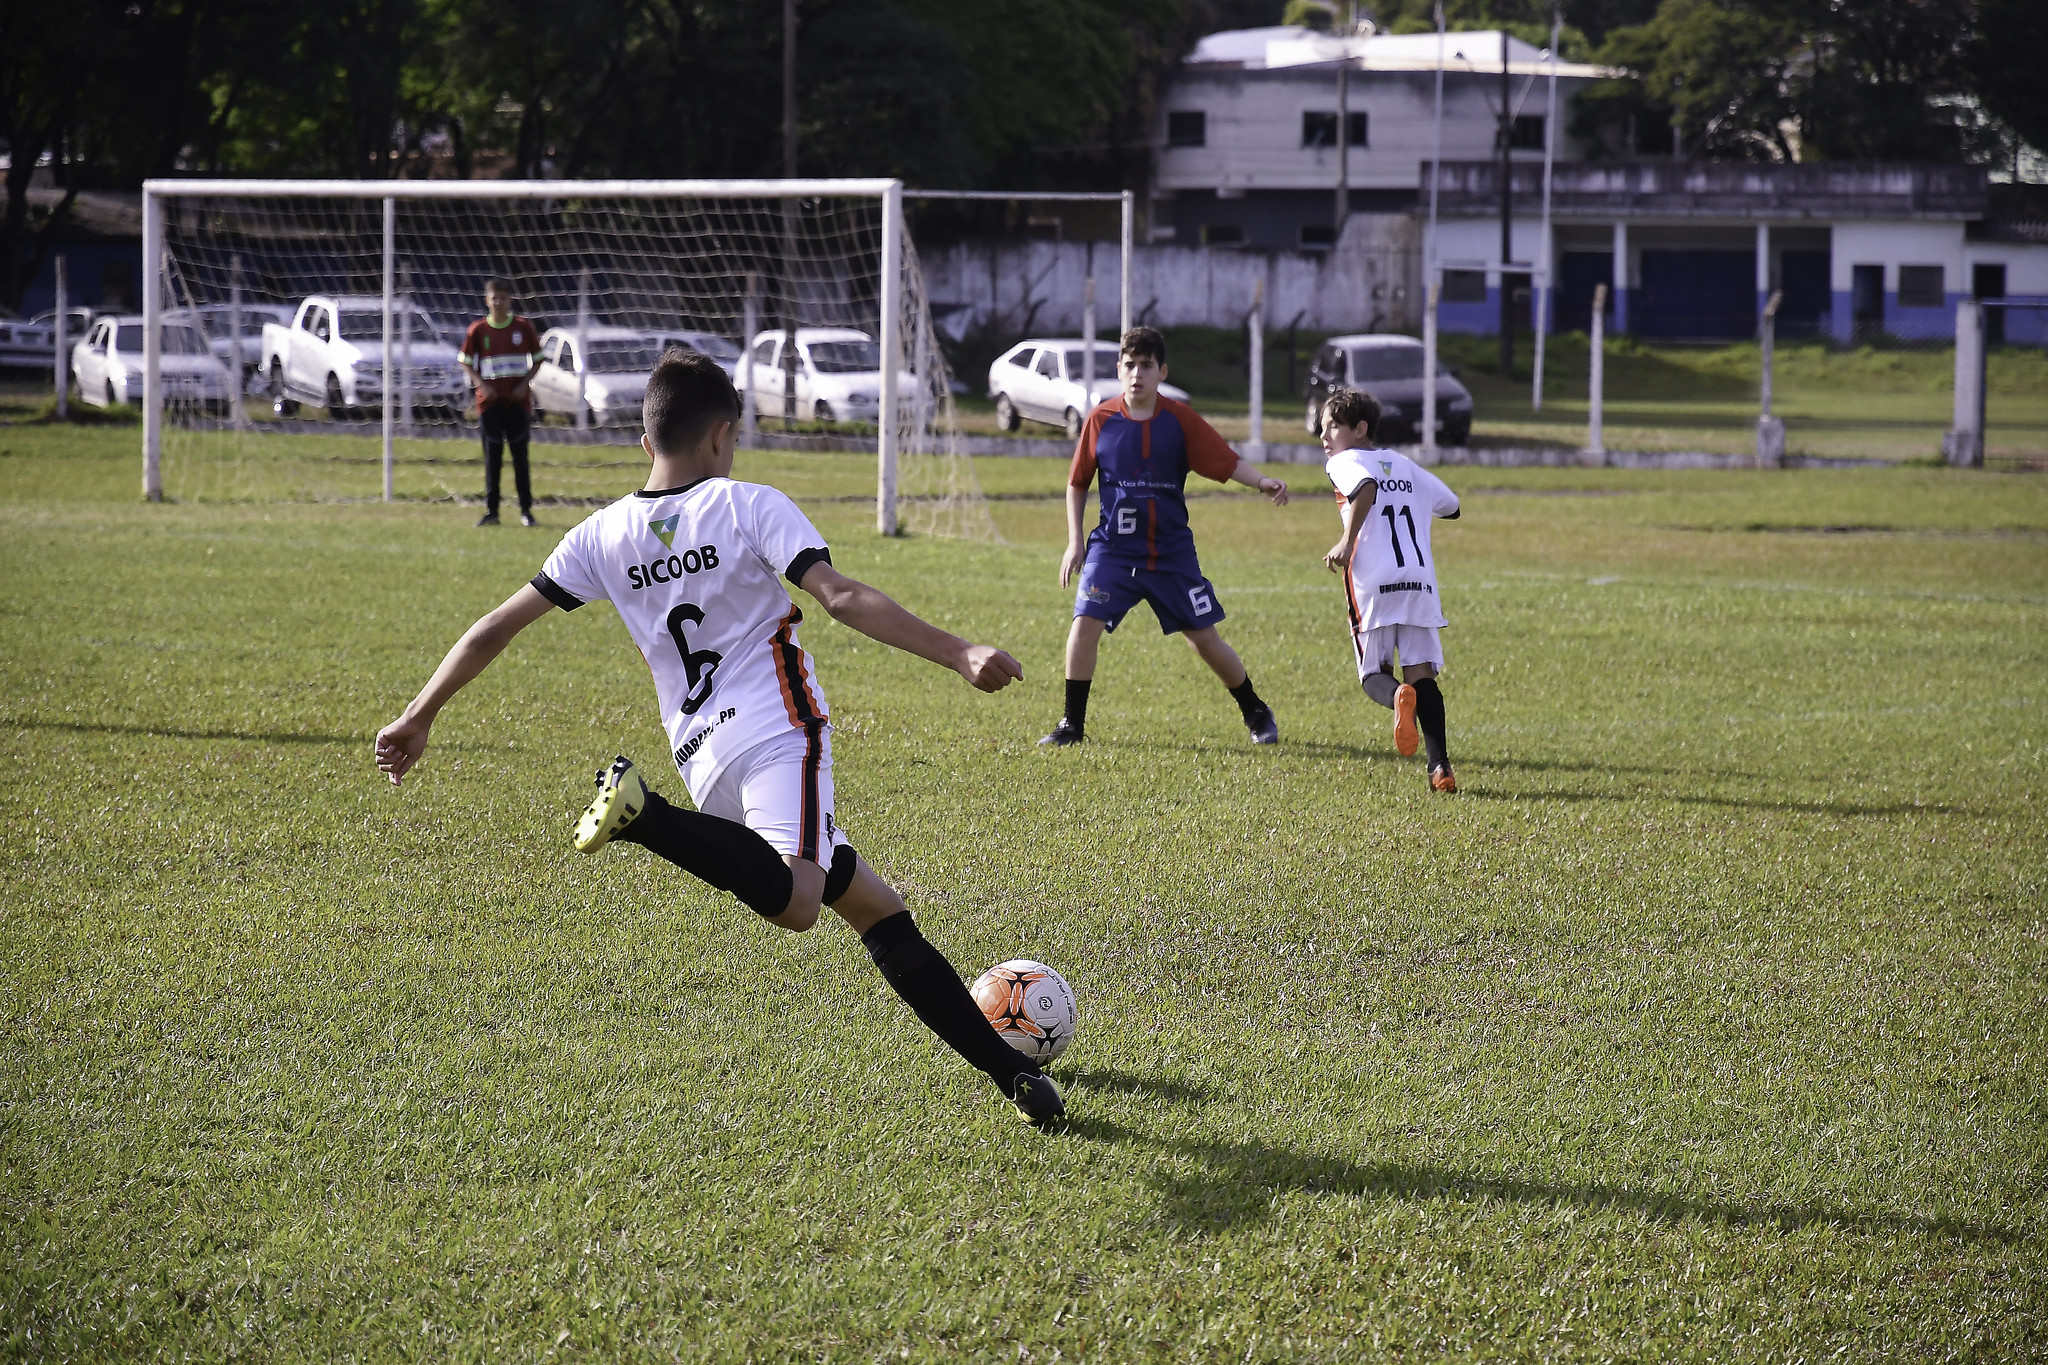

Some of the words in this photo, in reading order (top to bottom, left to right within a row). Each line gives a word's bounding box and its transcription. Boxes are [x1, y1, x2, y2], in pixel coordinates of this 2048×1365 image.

[1117, 507, 1137, 535] 6
[1381, 505, 1425, 568] 11
[627, 544, 720, 591] SICOOB
[1188, 585, 1213, 617] 6
[666, 602, 724, 716] 6
